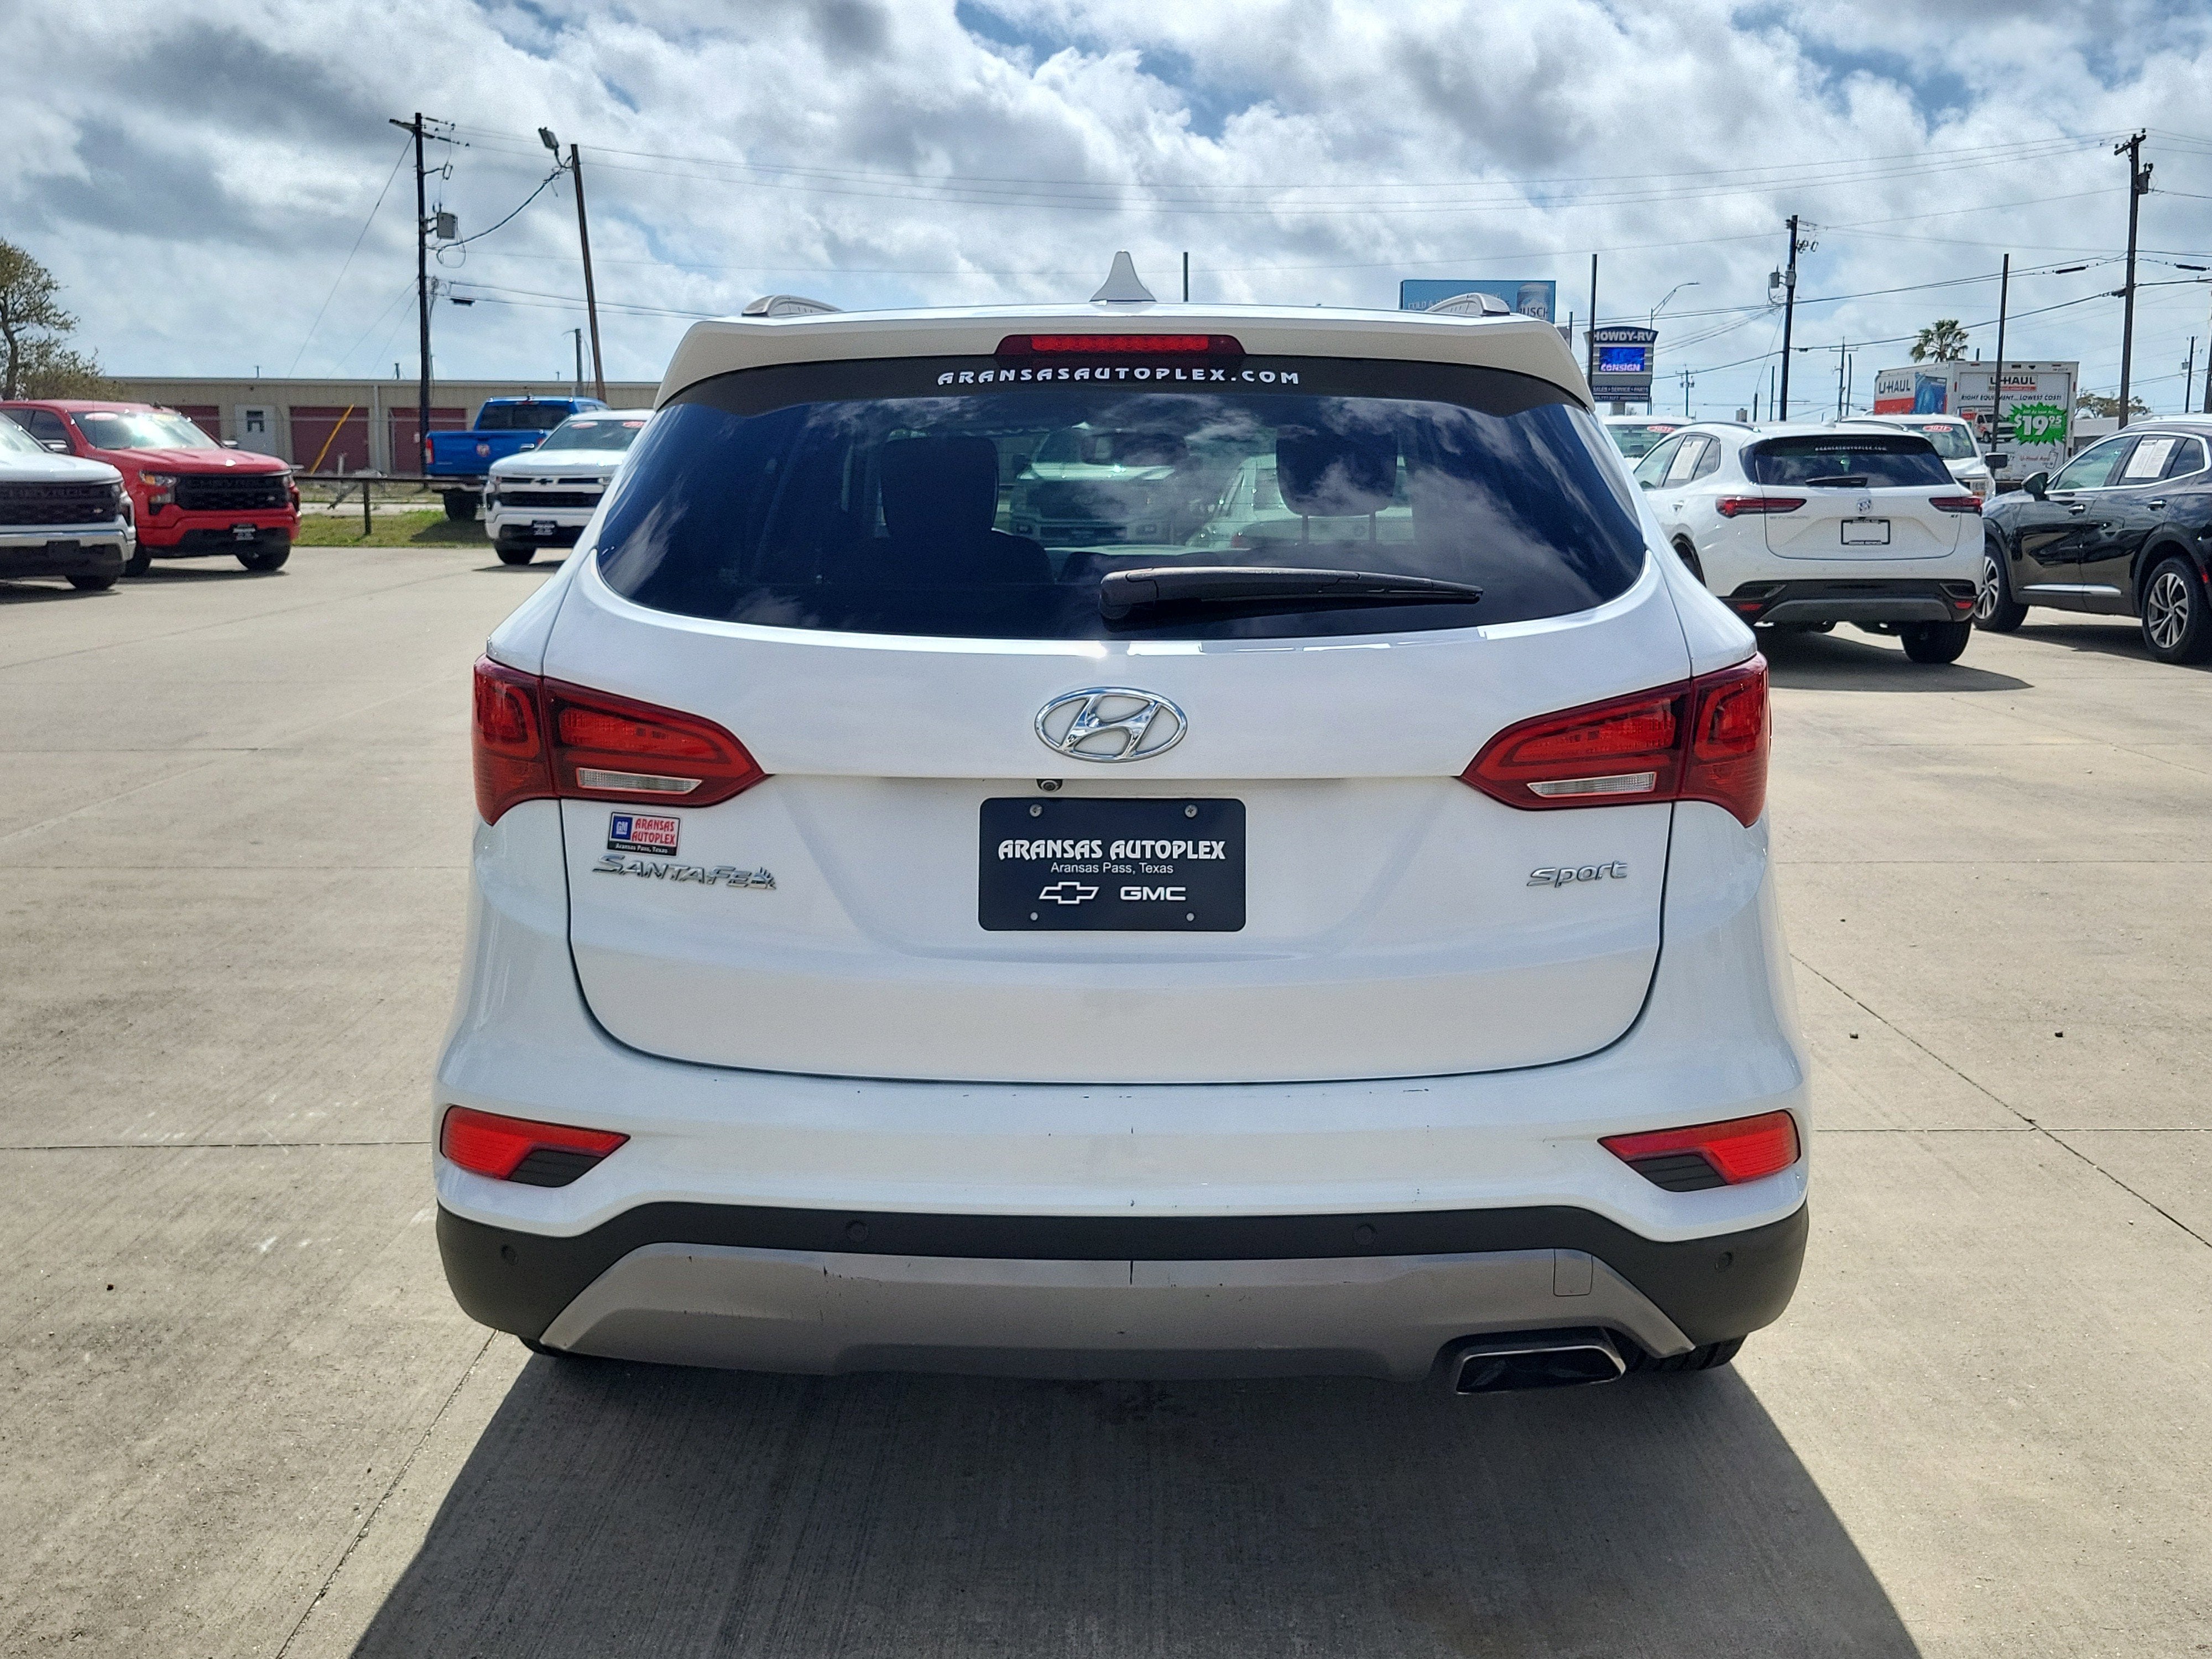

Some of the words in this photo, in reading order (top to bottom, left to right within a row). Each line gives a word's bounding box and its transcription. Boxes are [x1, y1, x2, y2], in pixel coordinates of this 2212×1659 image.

[937, 367, 1300, 386] ARANSASAUTOPLEX.COM
[1879, 379, 1911, 394] U-HAUL
[635, 818, 675, 832] ARANSAS
[632, 831, 675, 845] AUTOPLEX
[998, 839, 1102, 860] ARANSAS
[1109, 841, 1225, 860] AUTOPLEX
[1051, 862, 1099, 873] Aransas
[1103, 863, 1136, 875] Pass,
[1139, 863, 1173, 874] Texas
[1527, 860, 1627, 888] Sport
[1120, 887, 1186, 901] GMC
